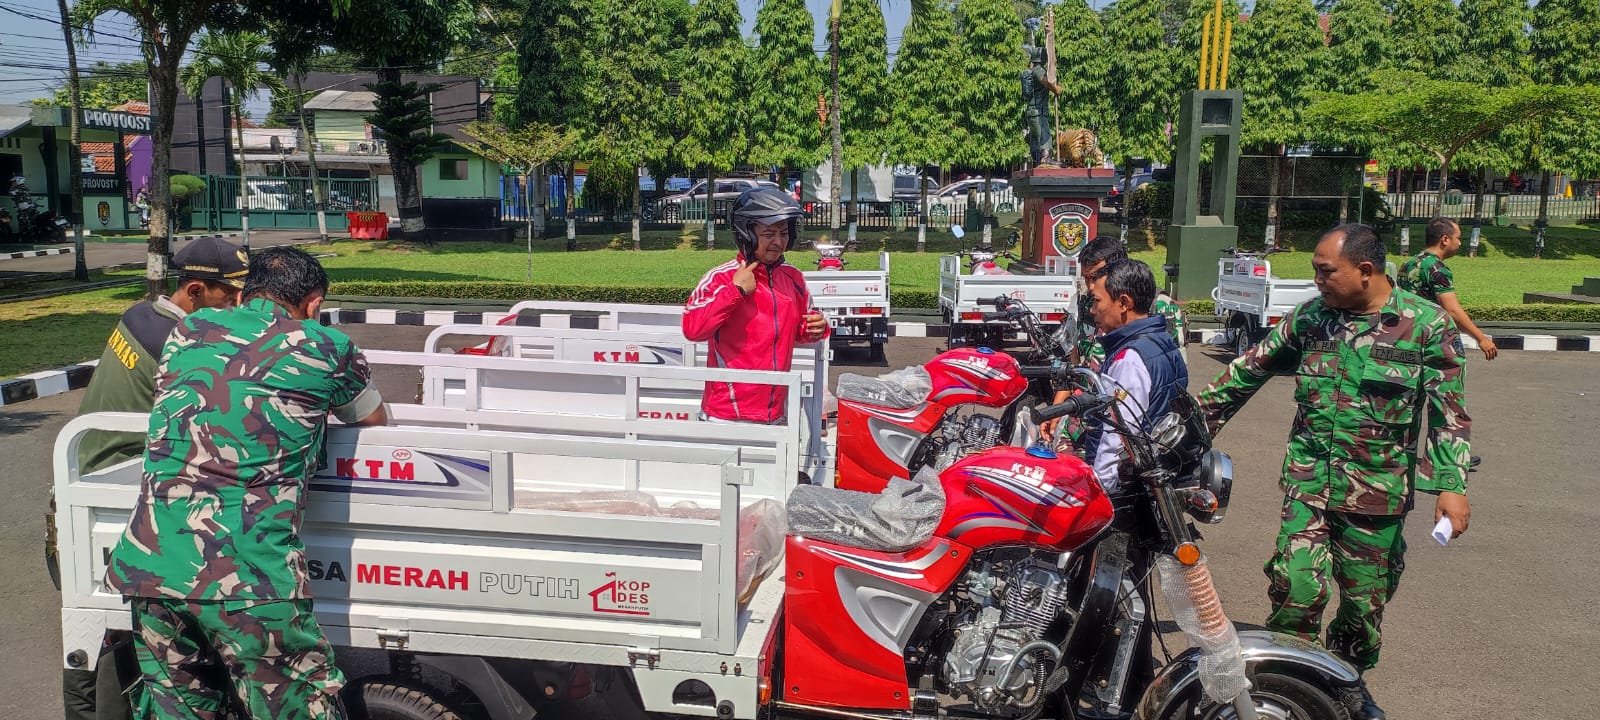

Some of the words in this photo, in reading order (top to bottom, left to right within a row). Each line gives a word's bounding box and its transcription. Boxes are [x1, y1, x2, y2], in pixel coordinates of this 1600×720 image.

[84, 110, 152, 130] PROVOOST
[108, 328, 139, 370] INMAS
[593, 351, 640, 363] KTM
[638, 411, 689, 421] ERAH
[336, 458, 414, 480] KTM
[307, 560, 347, 582] SA
[357, 563, 469, 591] MERAH
[479, 572, 580, 600] PUTIH
[617, 580, 651, 592] KOP
[617, 593, 649, 604] DES
